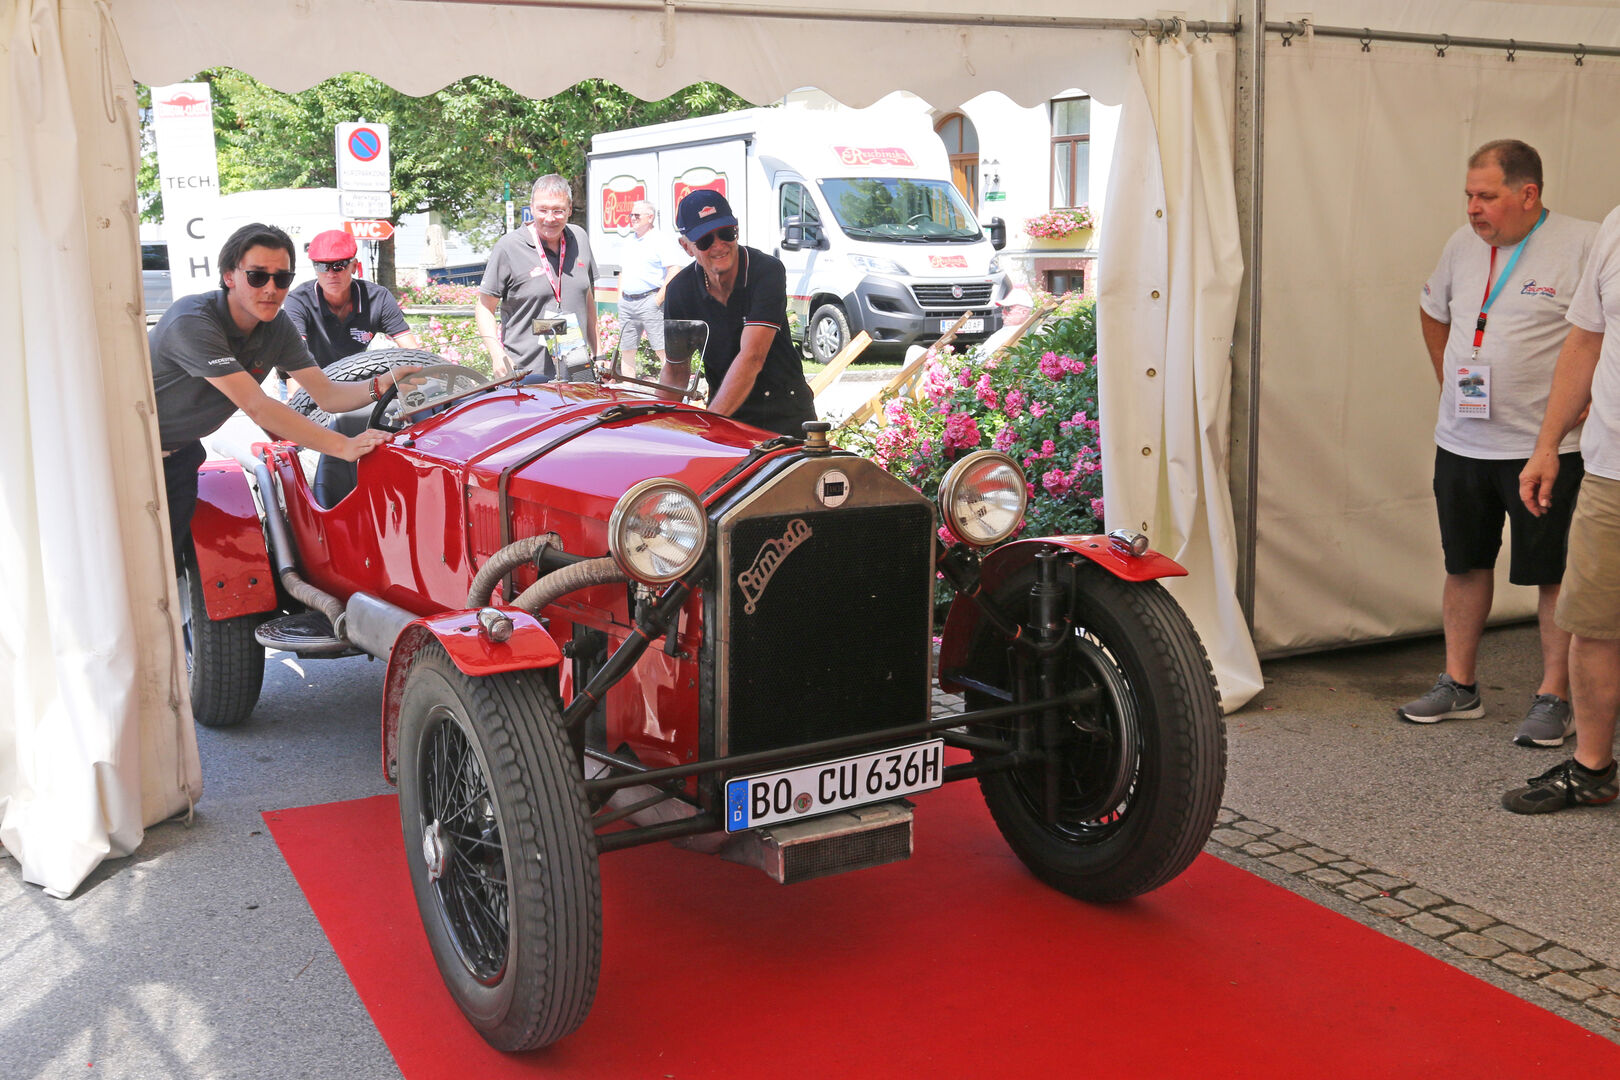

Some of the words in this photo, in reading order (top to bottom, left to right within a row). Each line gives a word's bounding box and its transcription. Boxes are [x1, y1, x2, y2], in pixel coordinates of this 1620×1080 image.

[166, 177, 216, 189] TECH.
[350, 222, 382, 237] WC
[737, 518, 813, 615] Lambda
[751, 777, 792, 820] BO
[818, 762, 858, 805] CU
[865, 745, 940, 795] 636H
[734, 810, 742, 822] D
